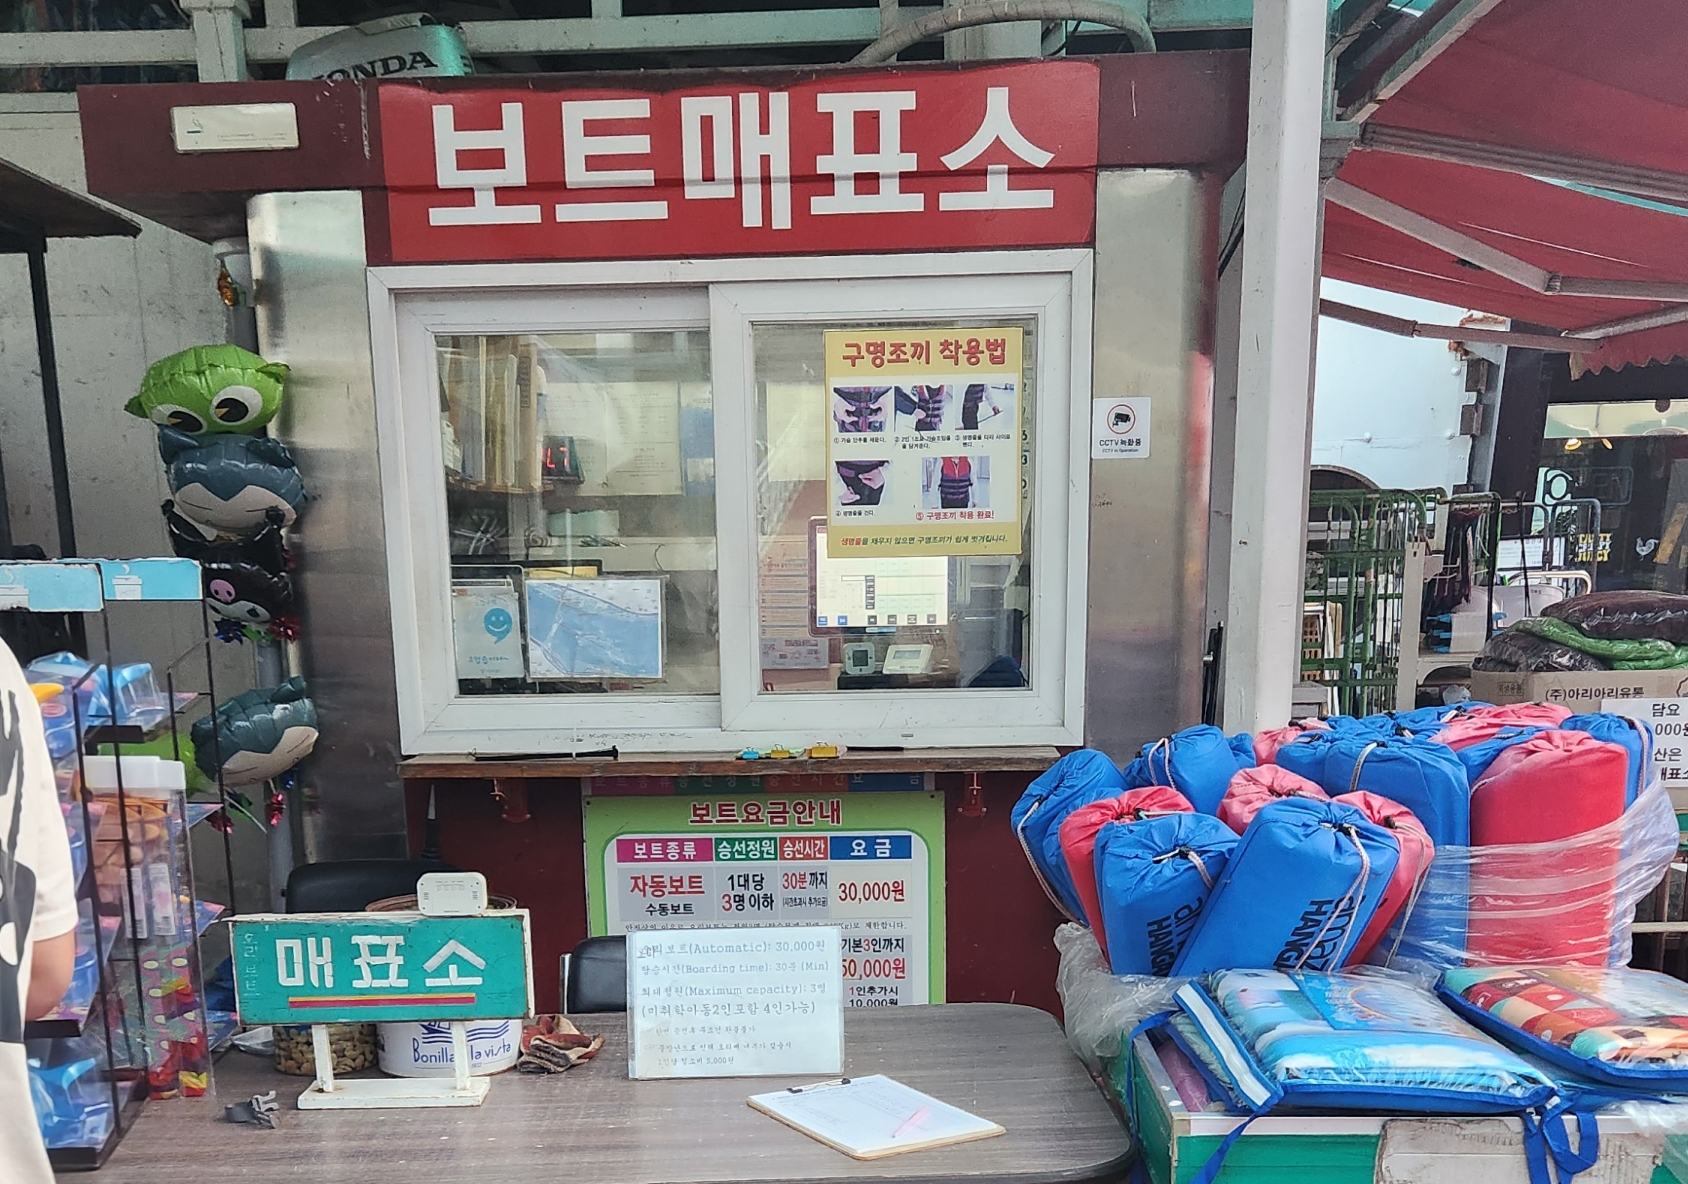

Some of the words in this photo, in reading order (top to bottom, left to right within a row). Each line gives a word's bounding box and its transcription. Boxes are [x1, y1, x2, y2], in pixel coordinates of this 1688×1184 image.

[313, 51, 438, 81] ONDA
[428, 87, 1056, 230] 보트매표소
[842, 340, 931, 368] 구명조끼
[938, 337, 1006, 366] 착용법
[1099, 439, 1119, 447] CCTV
[1120, 438, 1141, 447] 녹화중
[926, 511, 957, 521] 구명조끼
[959, 511, 975, 520] 착용
[976, 510, 995, 520] 완료!
[917, 536, 953, 545] 구명조끼가
[1545, 687, 1645, 701] (주)아리아리유통
[1652, 702, 1681, 718] 담요
[1654, 747, 1683, 762] 산은
[688, 799, 842, 826] 보트요금안내
[634, 841, 697, 860] 보트종류
[717, 840, 776, 860] 승선정원
[783, 839, 825, 859] 승선시간
[630, 874, 706, 899] 자동보트
[838, 880, 906, 905] 30,000원
[645, 903, 695, 916] 수동보트
[275, 934, 487, 989] 매표소
[740, 963, 772, 973] time):
[775, 962, 797, 973] 30분
[801, 960, 829, 972] (Min)
[746, 983, 807, 996] capacity):
[810, 982, 826, 994] 3명
[848, 985, 899, 996] 1인추가시
[471, 1044, 482, 1061] la
